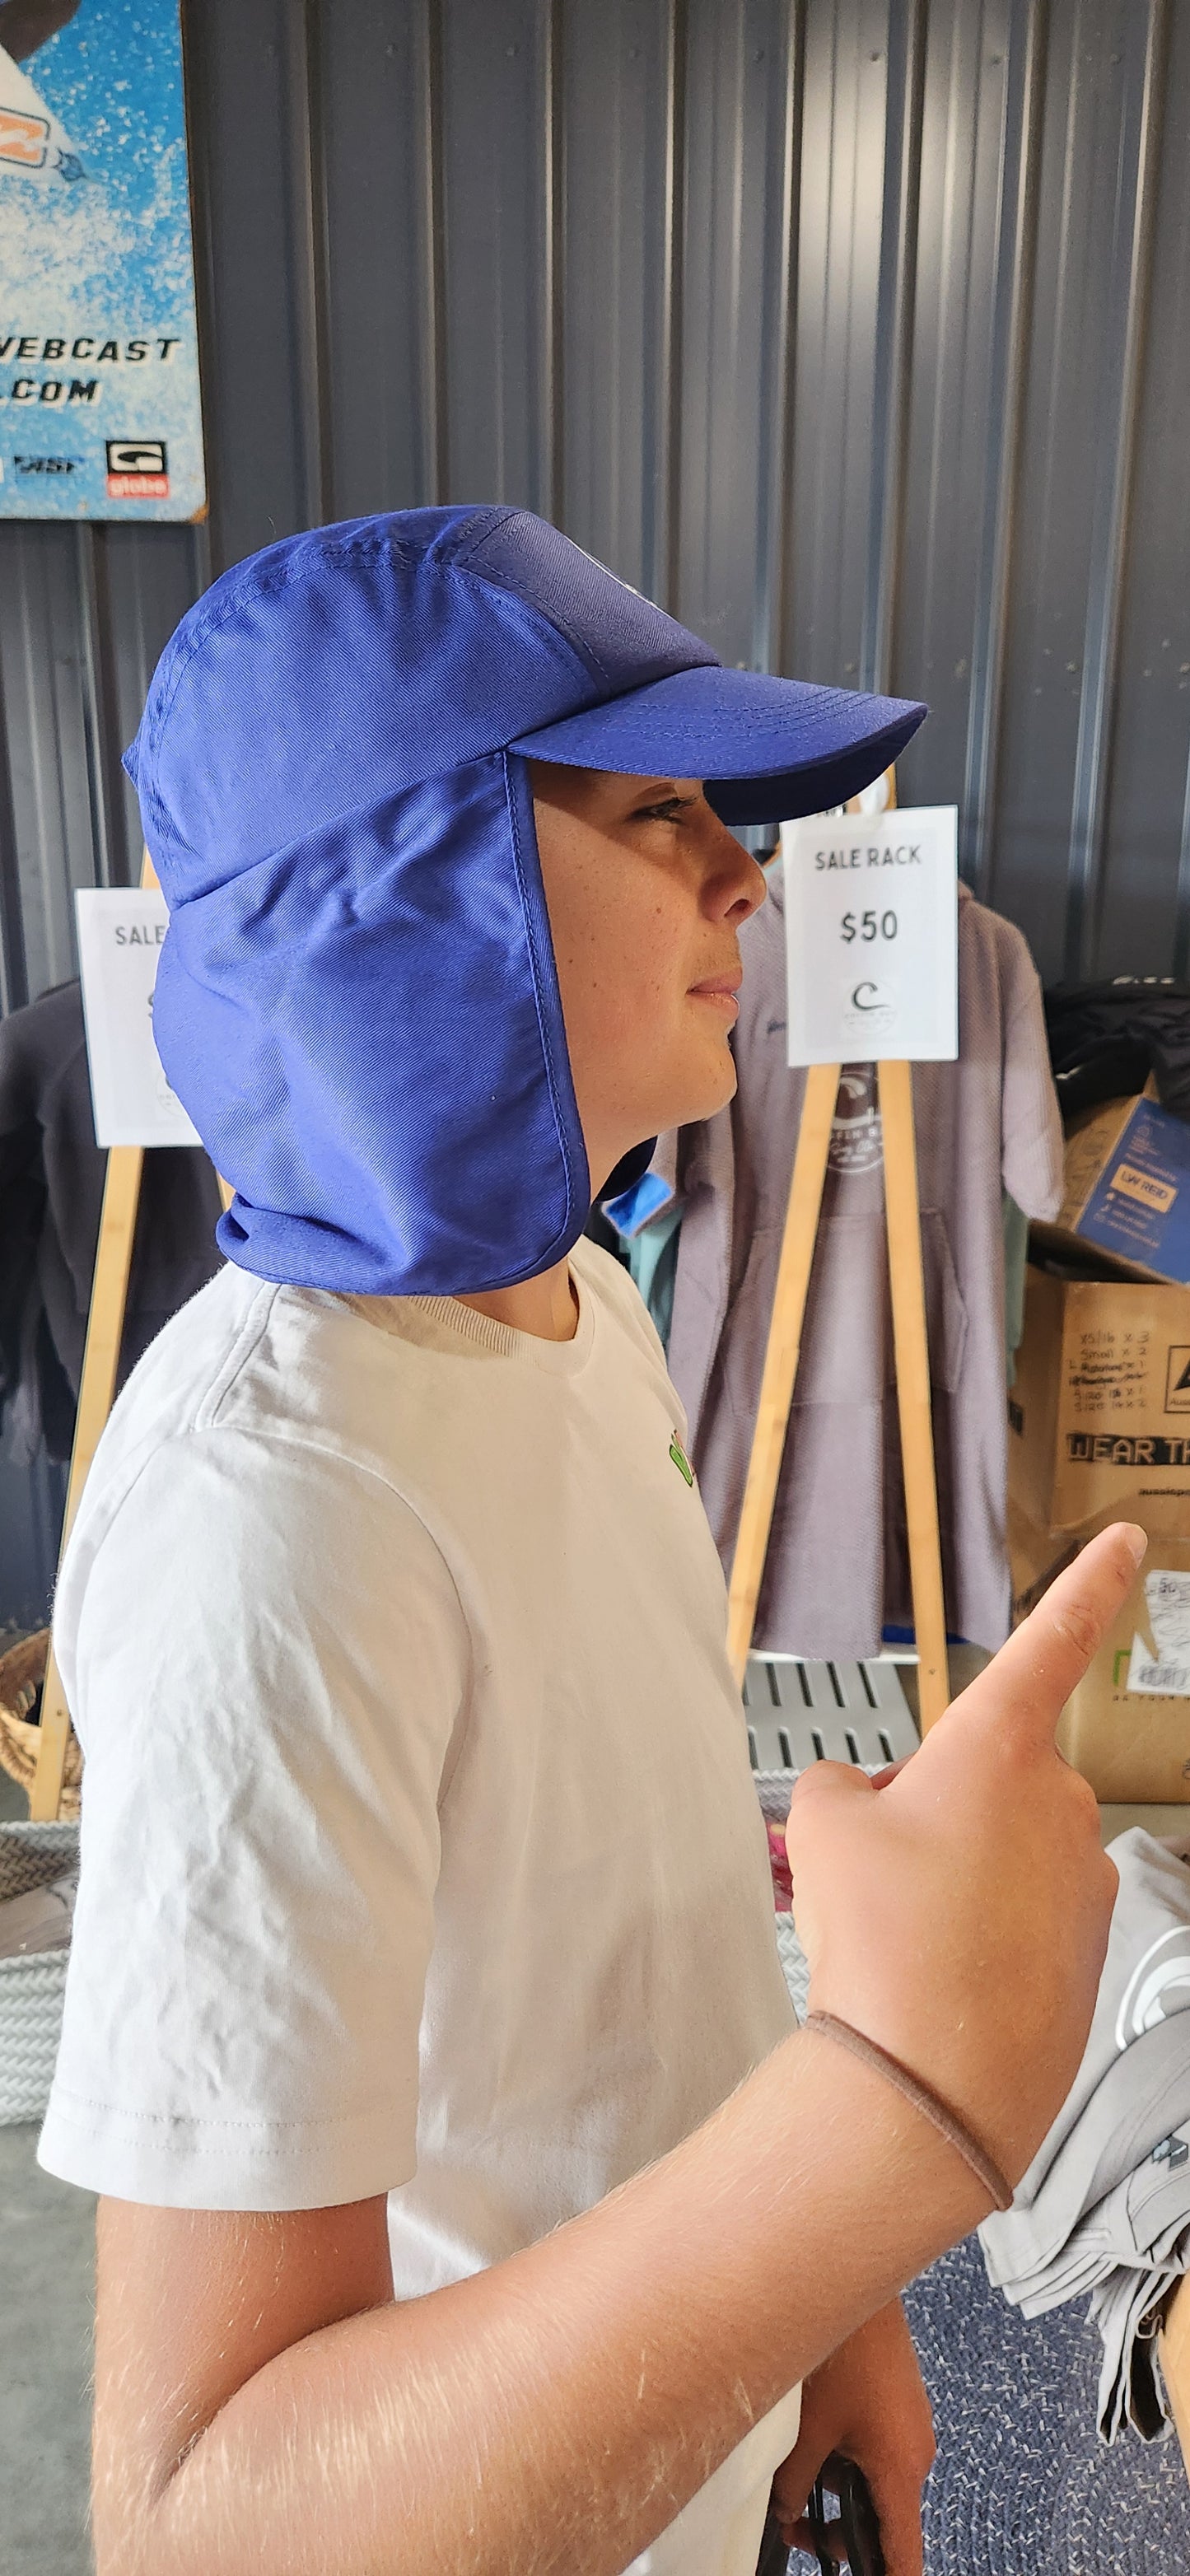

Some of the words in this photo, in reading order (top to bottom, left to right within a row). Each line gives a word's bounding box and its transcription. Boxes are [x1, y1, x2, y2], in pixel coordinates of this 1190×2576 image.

[815, 848, 861, 871] SALE
[867, 845, 921, 867] RACK
[115, 925, 165, 945] SALE
[841, 909, 898, 944] $50
[1069, 1437, 1155, 1464] WEAR
